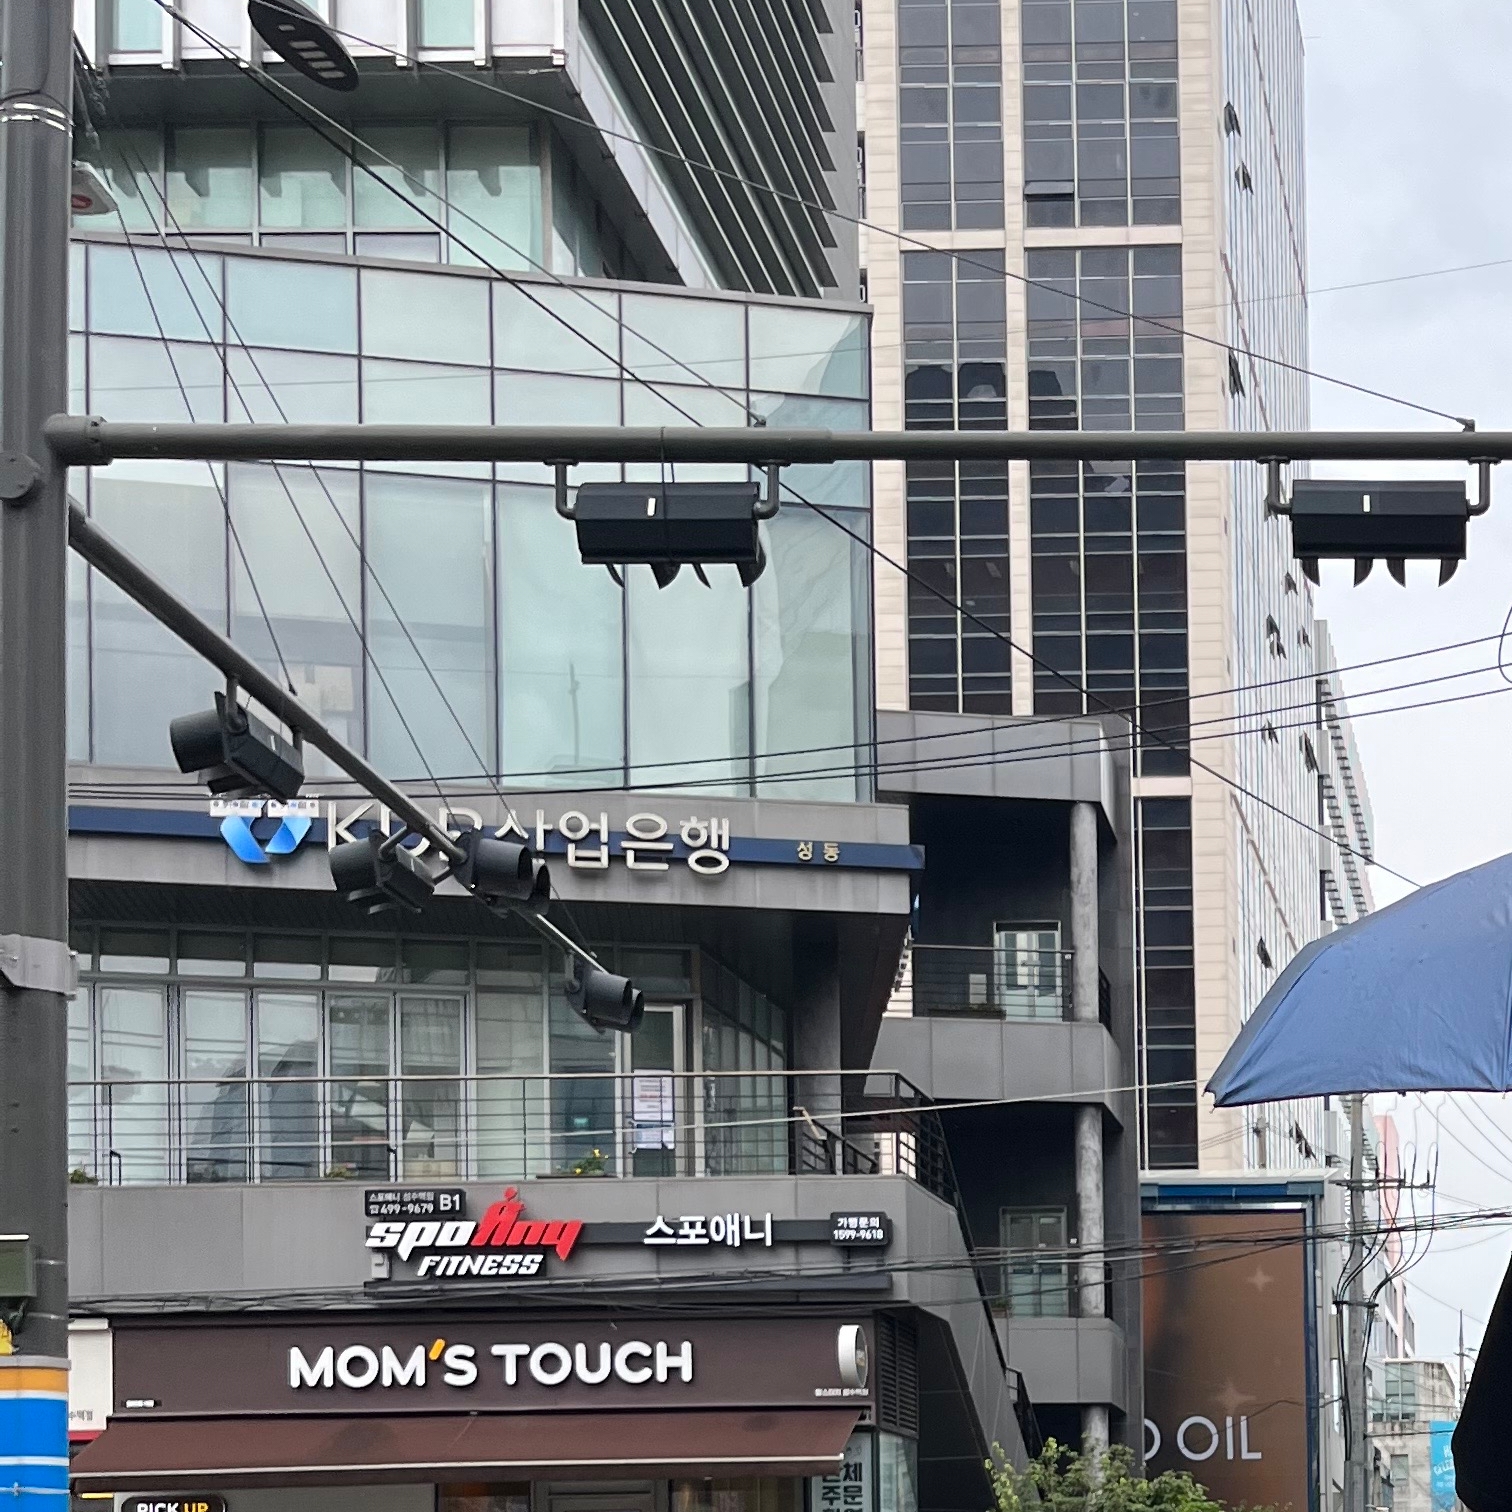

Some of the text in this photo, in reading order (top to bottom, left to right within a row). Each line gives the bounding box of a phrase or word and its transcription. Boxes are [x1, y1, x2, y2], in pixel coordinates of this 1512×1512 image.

[797, 841, 841, 862] 성동
[380, 1203, 434, 1215] 499-9679
[439, 1193, 460, 1211] B1
[643, 1212, 773, 1248] 스포애니
[417, 1252, 546, 1277] FITNESS
[288, 1339, 694, 1389] MOM'S TOUCH
[1177, 1415, 1263, 1461] OIL
[822, 1485, 864, 1507] 주문
